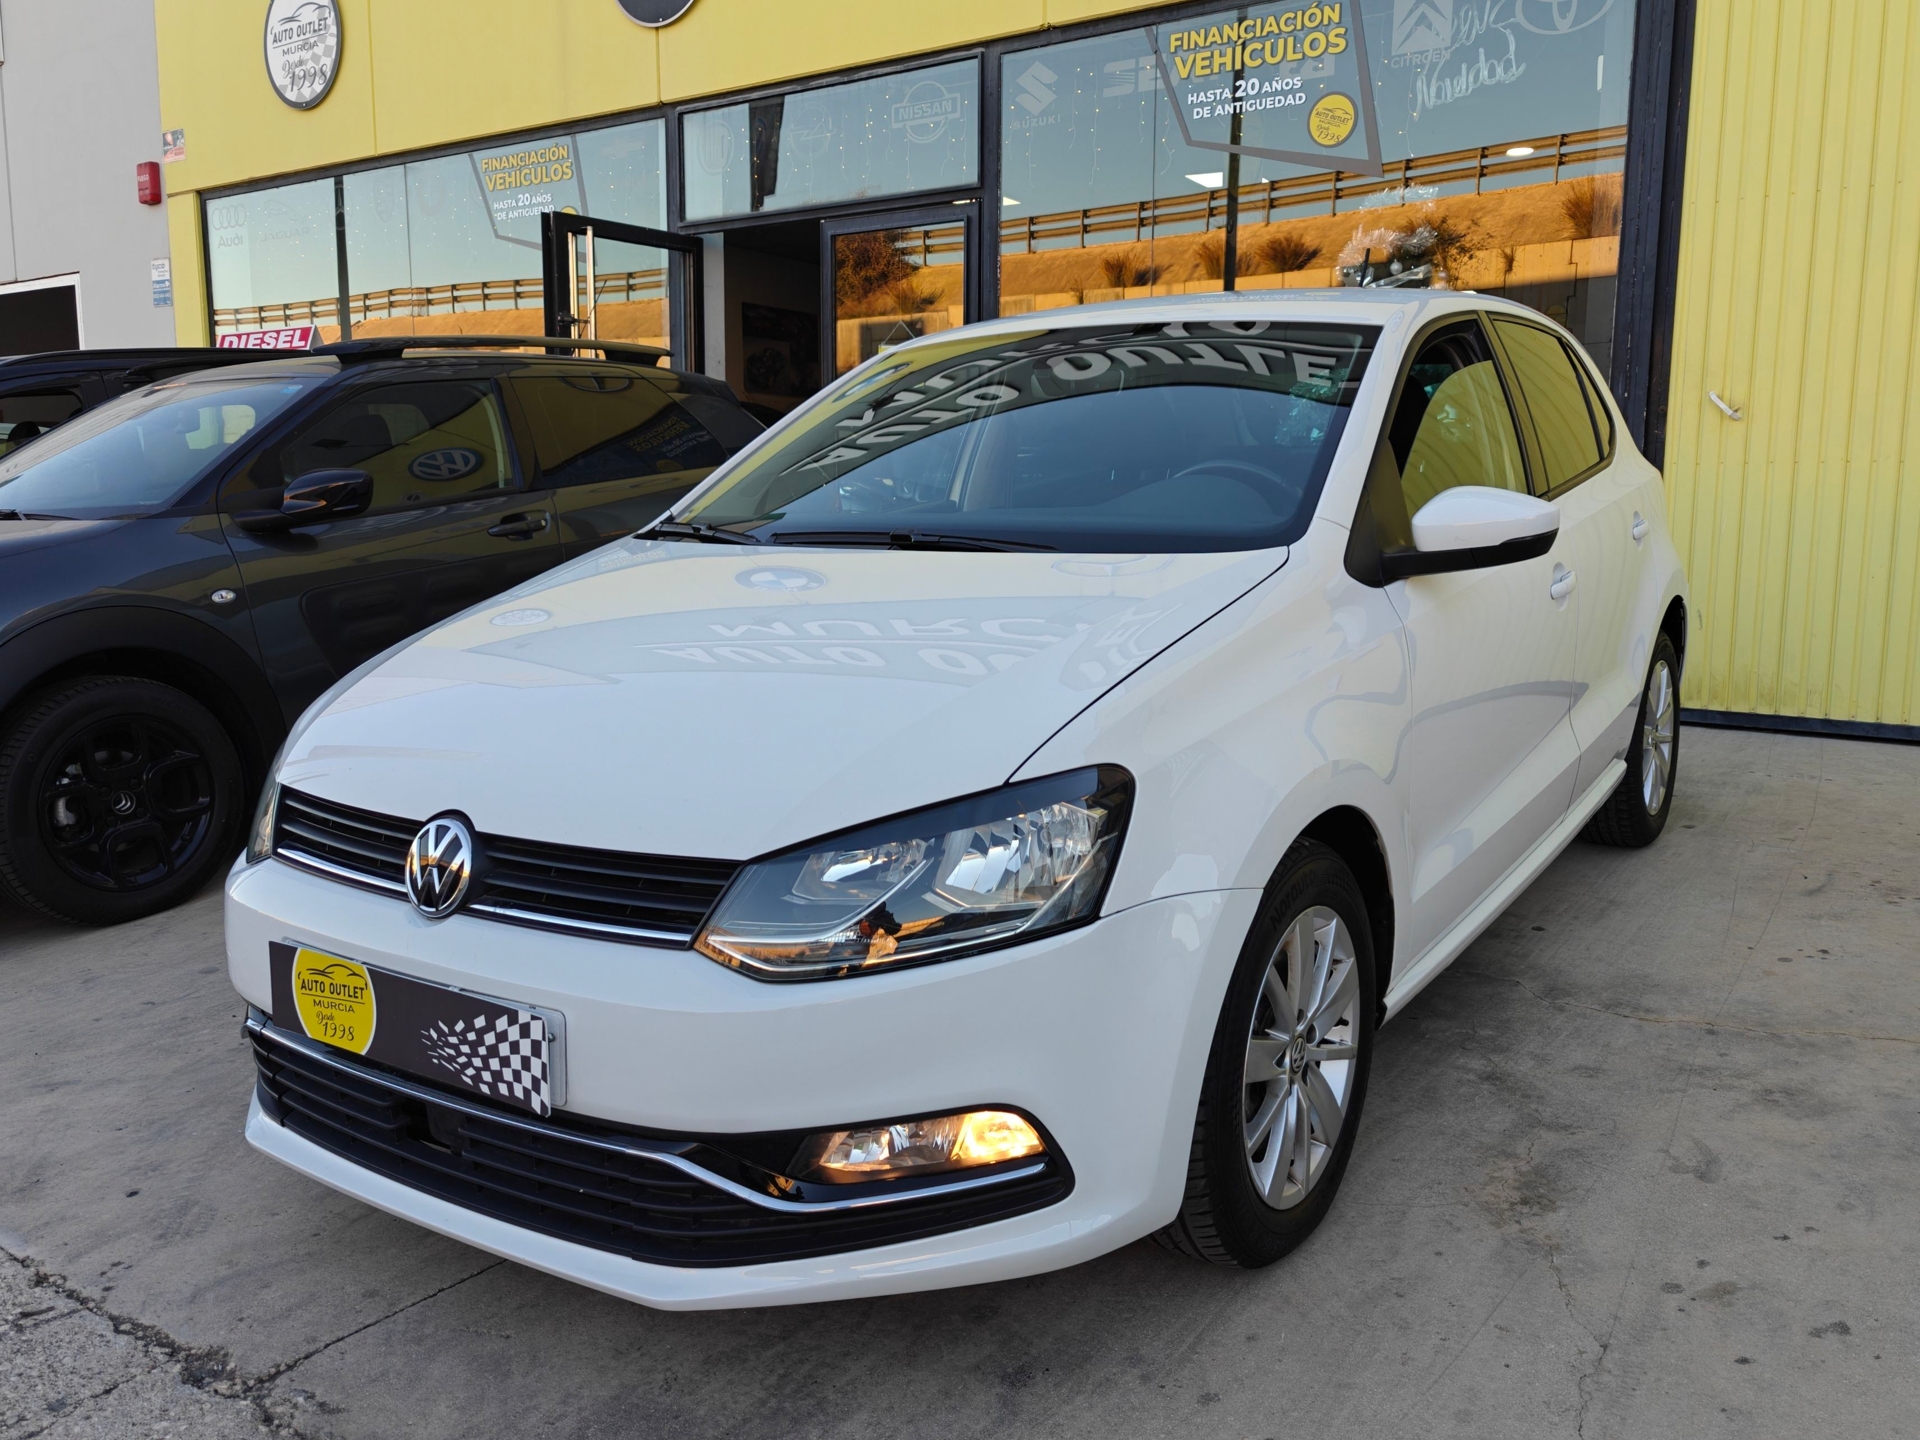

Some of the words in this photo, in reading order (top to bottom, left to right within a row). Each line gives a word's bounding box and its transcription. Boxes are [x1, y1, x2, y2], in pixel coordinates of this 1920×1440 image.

[272, 27, 294, 45] AUTO
[296, 17, 328, 38] OUTLET
[1169, 1, 1342, 54] FINANCIACIÓN
[282, 40, 319, 57] MURCIA
[1174, 27, 1349, 79] VEHÍCULOS
[289, 63, 328, 92] 1998
[1187, 87, 1232, 105] HASTA
[1234, 78, 1260, 98] 20
[1262, 77, 1303, 94] AÑOS
[898, 100, 952, 121] NISSAN
[1193, 107, 1212, 120] DE
[1214, 92, 1307, 117] ANTIGUEDAD
[1012, 114, 1061, 130] SUZUKI
[1330, 115, 1350, 123] OUTLET
[1318, 130, 1341, 142] 1998
[482, 144, 568, 173] FINANCIACIÓN
[485, 160, 574, 192] VEHÍCULOS
[494, 199, 517, 210] HASTA
[517, 193, 531, 206] 20
[531, 193, 552, 204] AÑOS
[497, 211, 507, 220] DE
[218, 233, 243, 248] Audi
[260, 227, 310, 242] JAGUAR
[222, 329, 306, 349] DIESEL
[301, 978, 325, 993] AUTO
[329, 982, 365, 1000] OUTLET
[313, 999, 355, 1013] MURCIA
[322, 1021, 355, 1042] 1998
